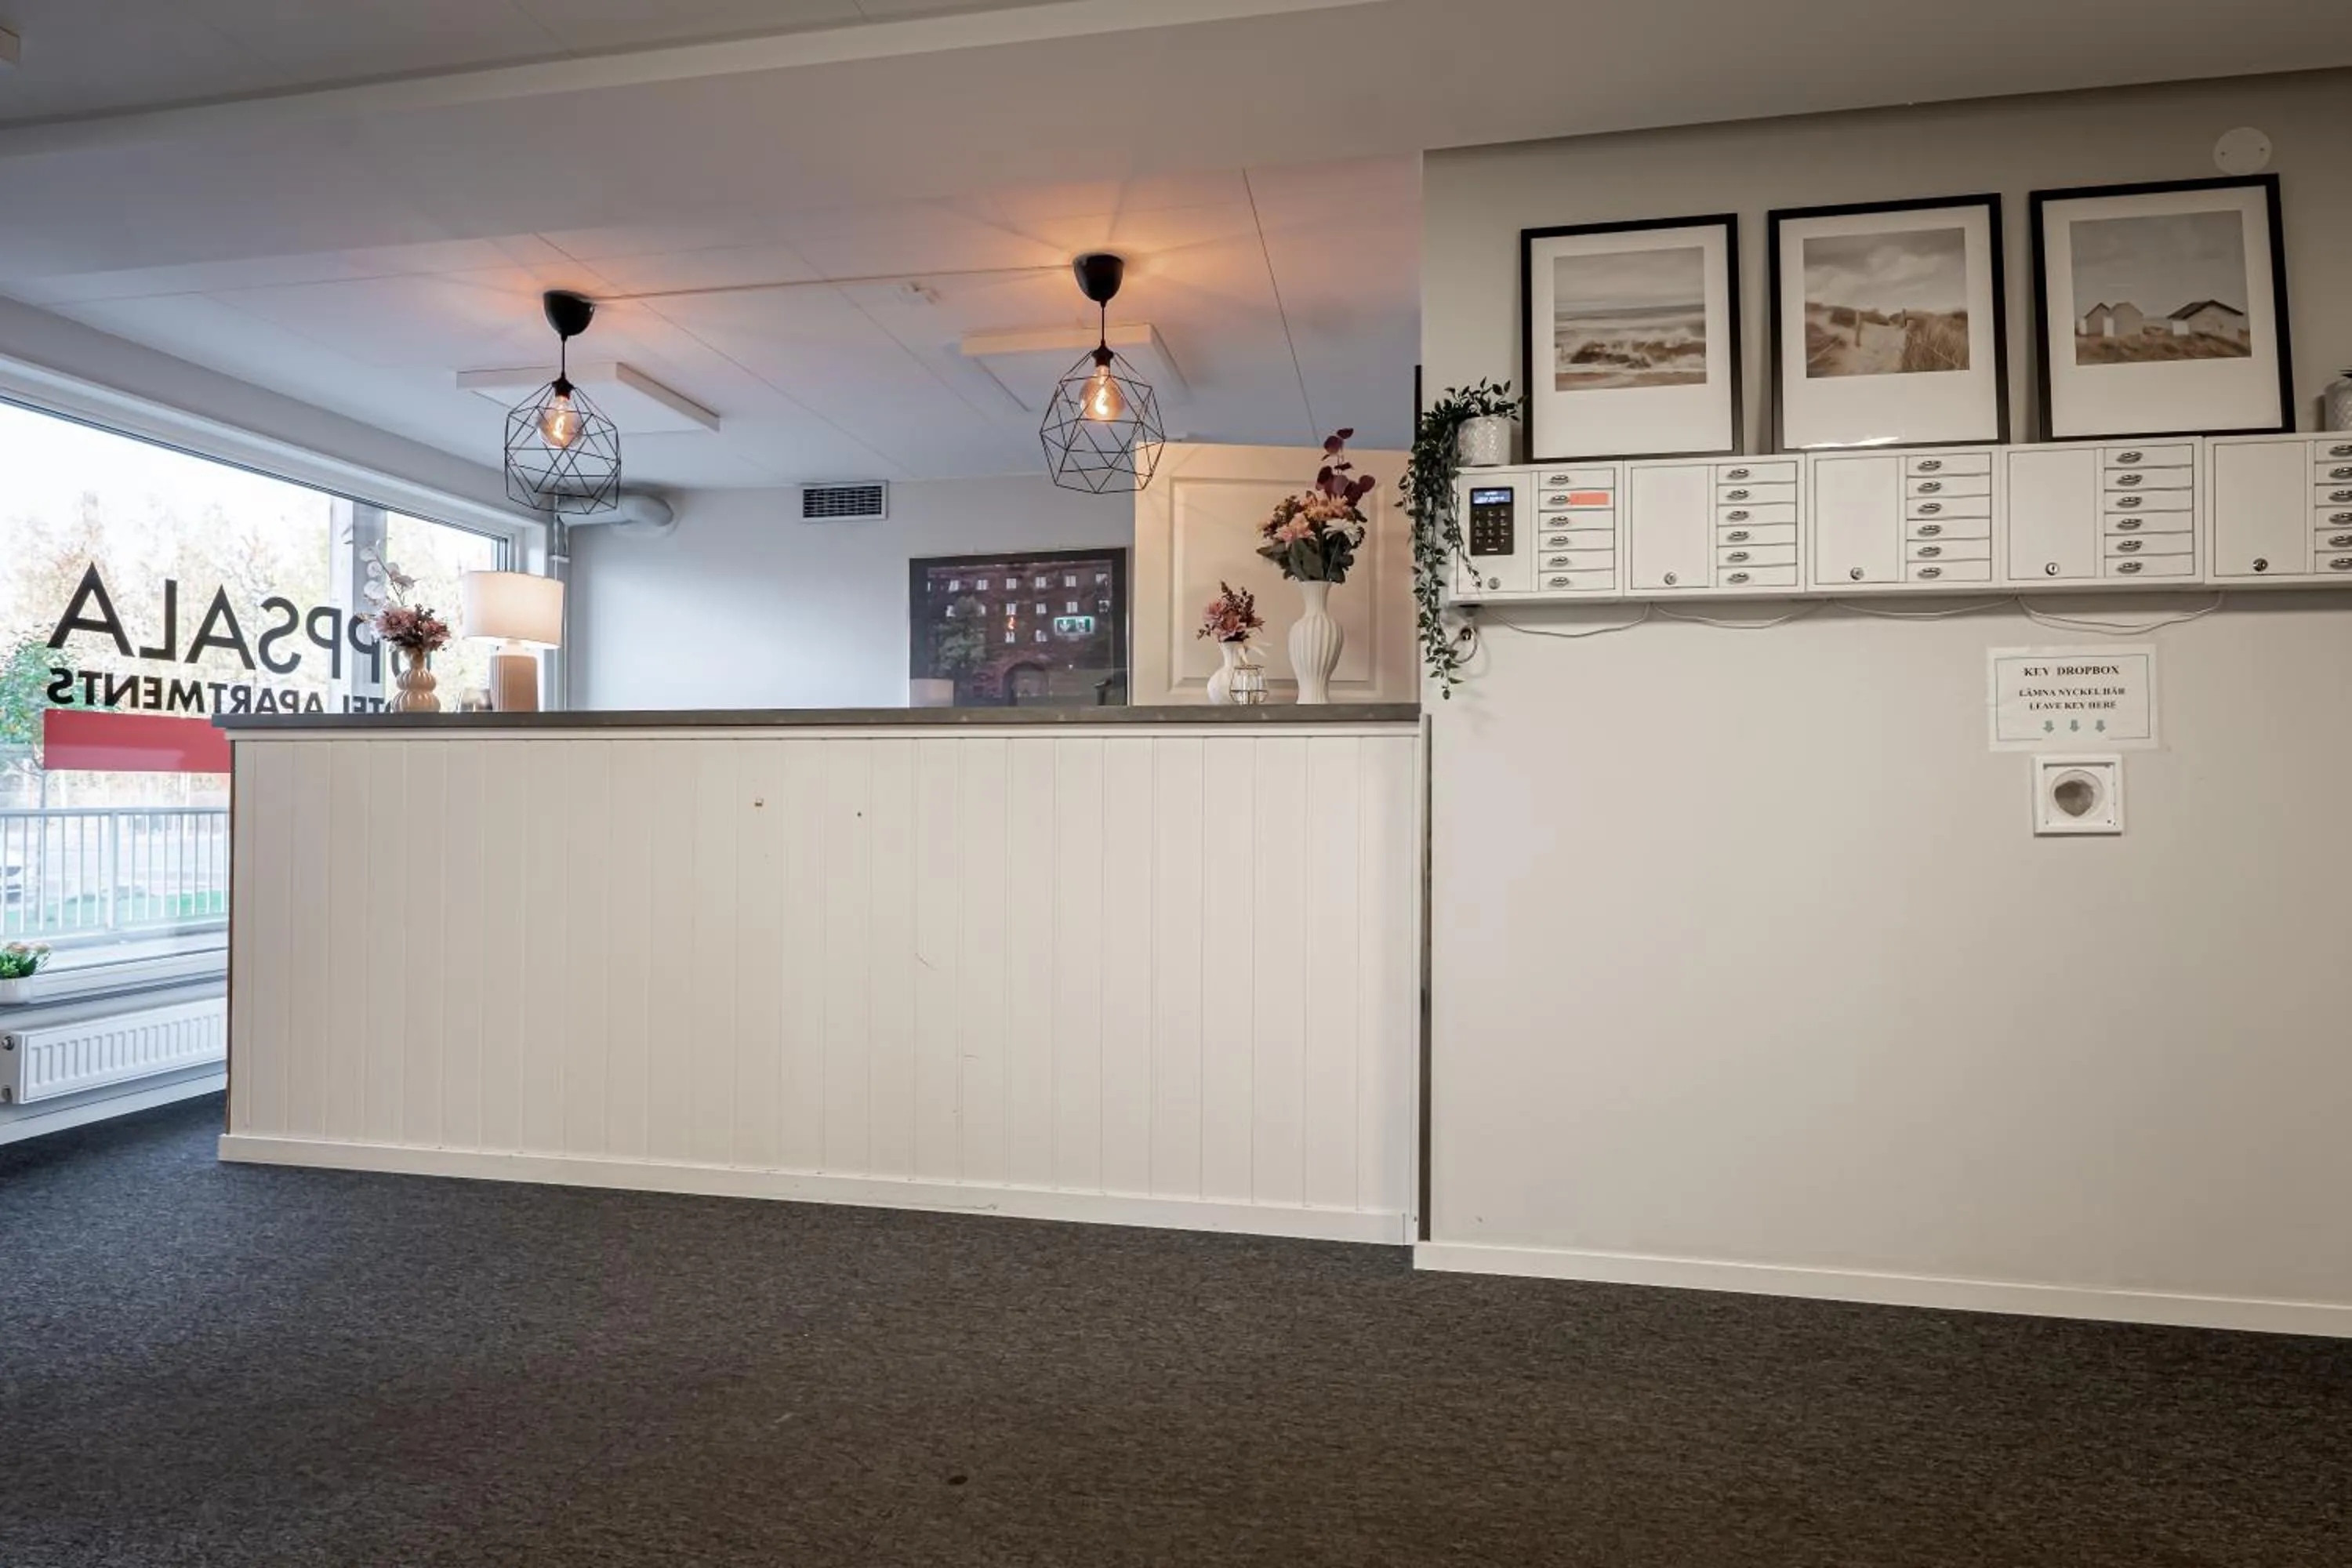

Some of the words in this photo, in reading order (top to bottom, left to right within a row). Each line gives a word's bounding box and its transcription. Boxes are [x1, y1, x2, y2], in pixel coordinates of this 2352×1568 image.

[2024, 666, 2049, 677] KEY
[2057, 666, 2120, 676] DROPBOX
[2058, 688, 2100, 696] NYCKEL
[2088, 701, 2117, 710] HERE
